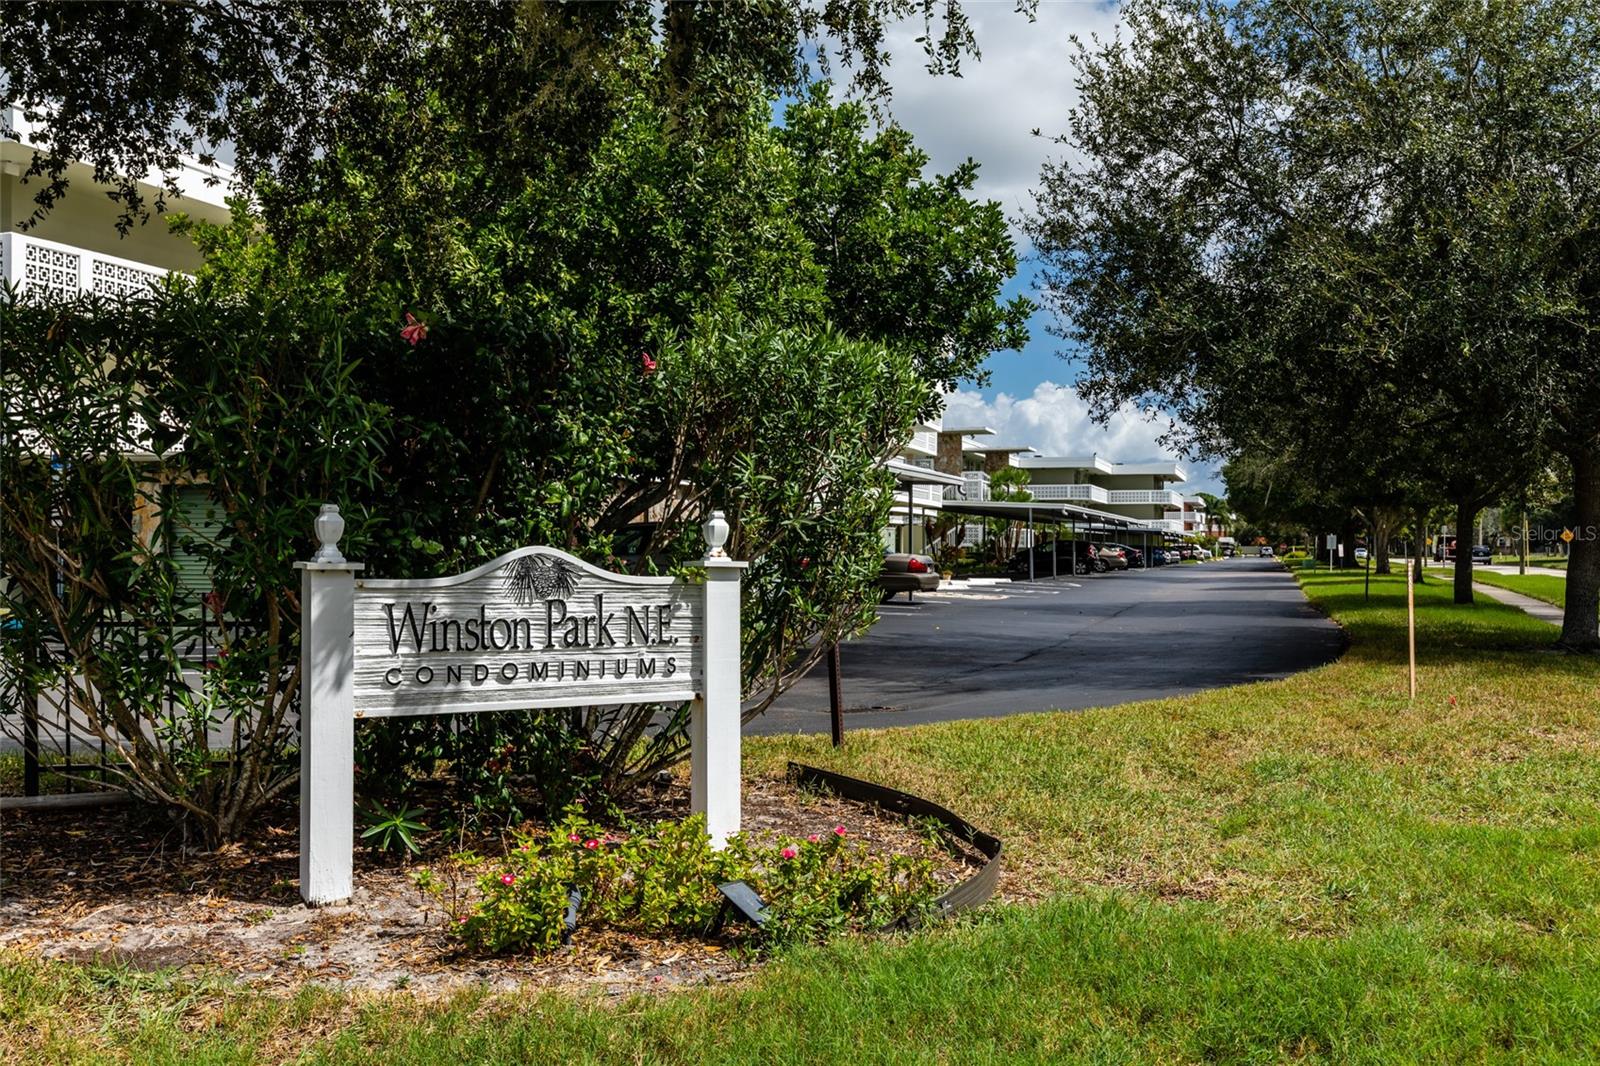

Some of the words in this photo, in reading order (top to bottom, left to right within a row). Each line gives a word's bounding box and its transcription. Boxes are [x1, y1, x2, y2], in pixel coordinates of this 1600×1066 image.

[384, 602, 534, 655] Winston
[545, 593, 617, 648] Park
[624, 604, 679, 645] N.E.
[385, 657, 677, 686] CONDOMINIUMS
